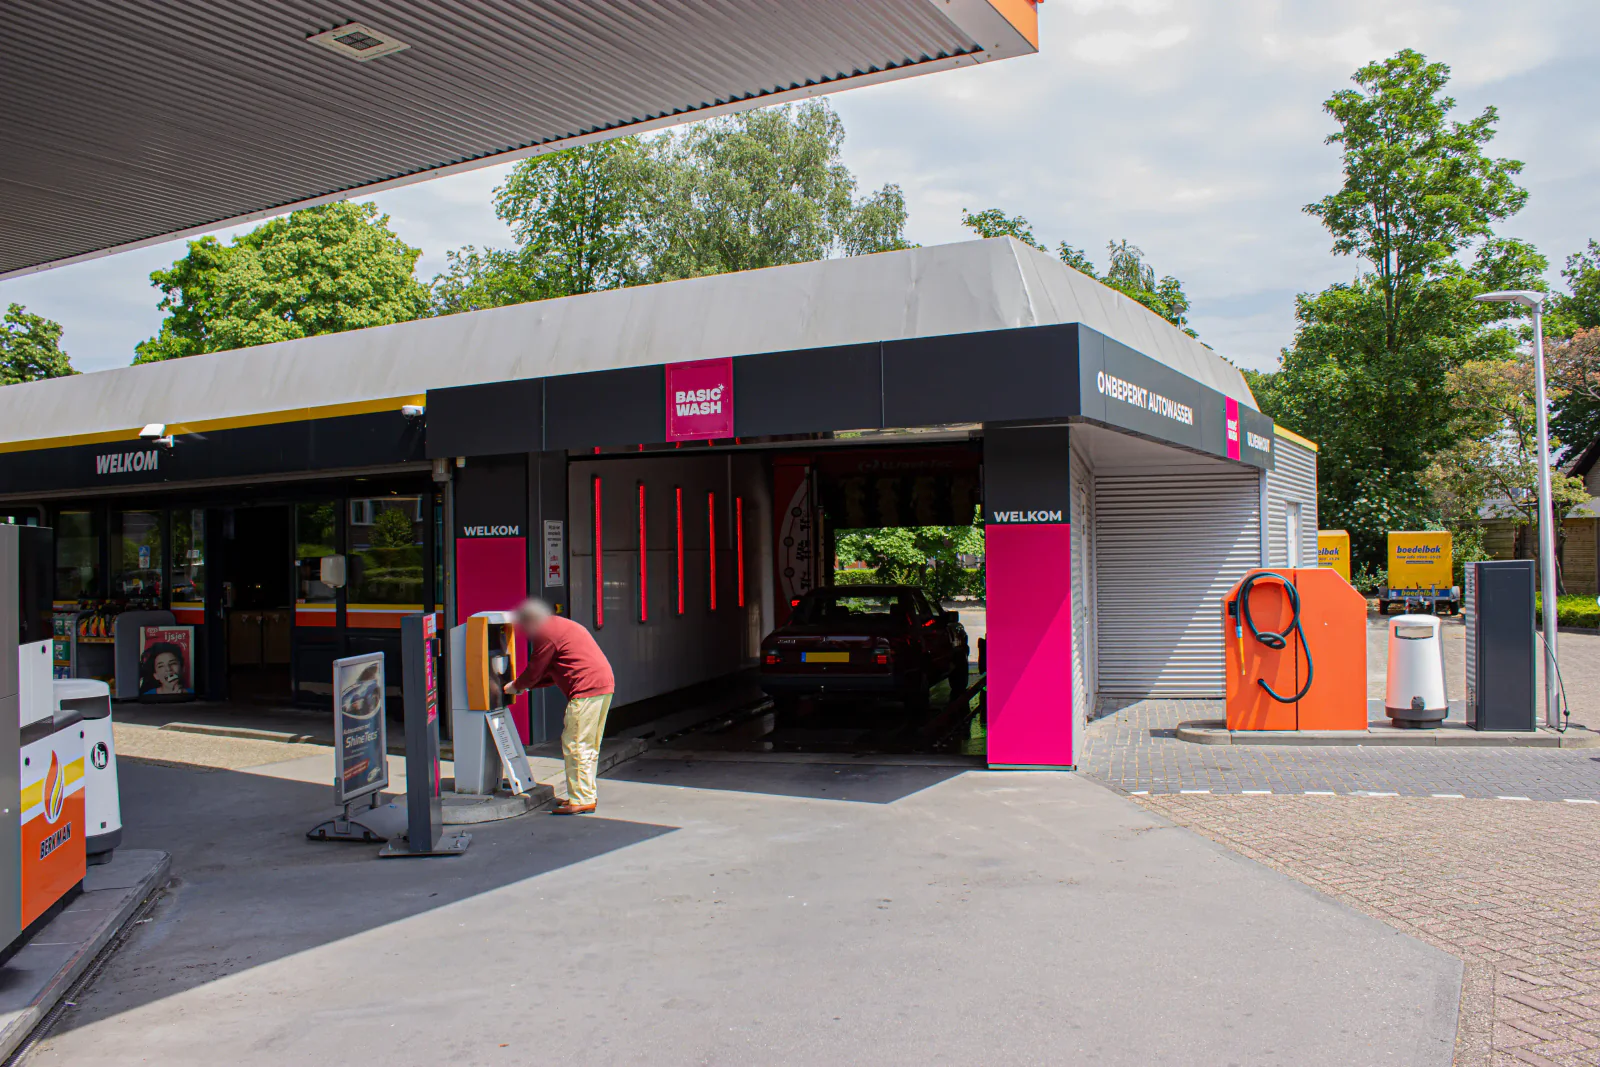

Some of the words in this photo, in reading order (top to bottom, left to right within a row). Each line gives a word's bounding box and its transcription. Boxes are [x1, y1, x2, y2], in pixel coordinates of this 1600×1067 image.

[675, 387, 722, 403] BASIC
[1097, 370, 1148, 409] ONBEPERKT
[1148, 391, 1193, 425] AUTOWASSEN
[675, 401, 722, 417] WASH
[96, 450, 159, 475] WELKOM
[994, 510, 1062, 523] WELKOM
[463, 525, 520, 537] WELKOM
[1318, 547, 1339, 556] elbak
[1396, 545, 1441, 554] boedelbak
[164, 631, 186, 643] ijsje?
[40, 821, 72, 861] BERKMAN
